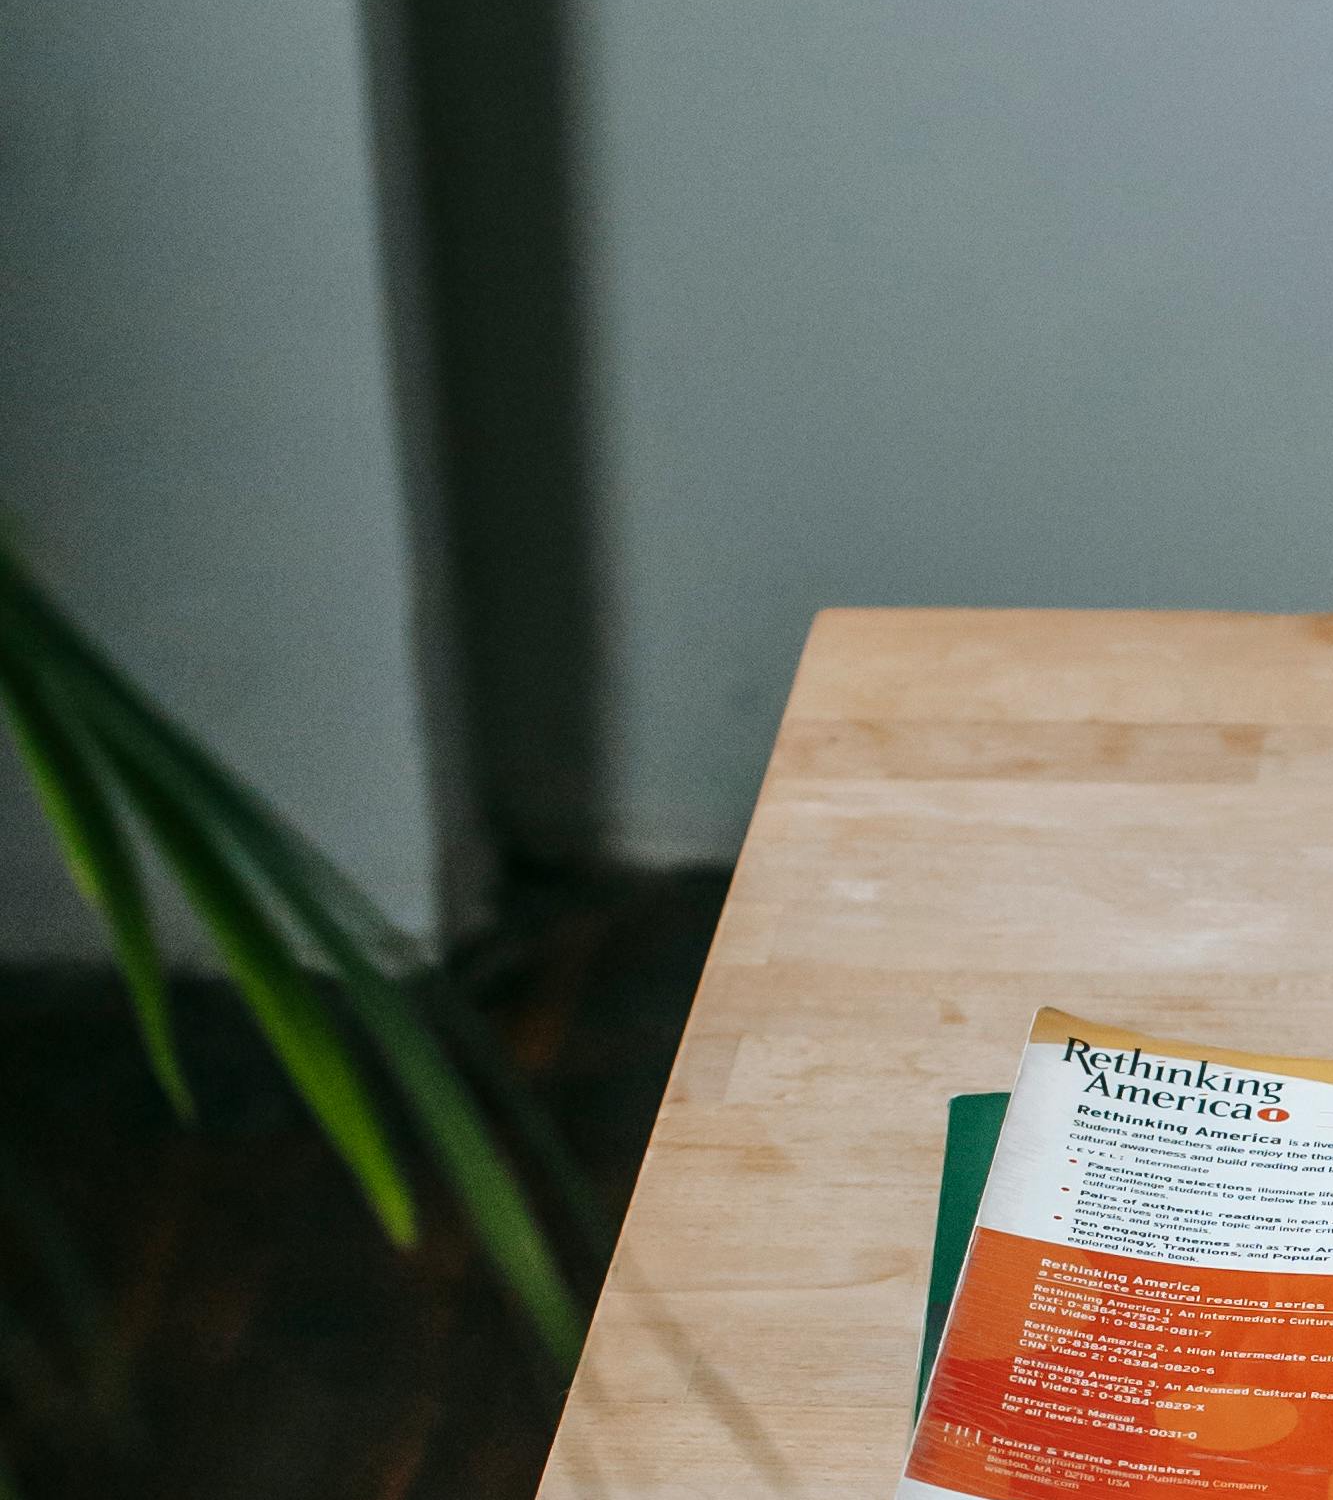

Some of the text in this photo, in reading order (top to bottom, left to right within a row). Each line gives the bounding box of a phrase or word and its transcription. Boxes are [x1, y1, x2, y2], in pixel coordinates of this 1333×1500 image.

[1062, 1036, 1284, 1104] Rethinking
[1084, 1071, 1251, 1121] America
[1073, 1119, 1128, 1136] Students
[1131, 1132, 1154, 1141] and
[1158, 1135, 1212, 1150] teachers
[1215, 1145, 1245, 1153] alike
[1248, 1149, 1283, 1158] enjoy
[1286, 1151, 1307, 1159] the
[1077, 1104, 1188, 1134] Rethinking
[1194, 1126, 1281, 1145] America
[1069, 1133, 1117, 1146] cultural
[1119, 1143, 1186, 1158] awareness
[1189, 1154, 1214, 1162] and
[1216, 1156, 1248, 1166] build
[1250, 1161, 1298, 1172] reading
[1040, 1258, 1200, 1292] Rethinking America
[1053, 1273, 1130, 1292] complete
[1134, 1287, 1201, 1302] cultural
[1206, 1296, 1269, 1308] reading
[1275, 1301, 1325, 1310] series
[1028, 1302, 1056, 1313] CNN
[1060, 1307, 1096, 1321] Video
[1032, 1292, 1062, 1305] Text:
[1034, 1283, 1102, 1306] Rethinking
[1106, 1299, 1160, 1314] America
[1178, 1309, 1195, 1318] An
[1199, 1312, 1285, 1324] Intermediate
[1019, 1338, 1046, 1350] CNN
[1050, 1344, 1087, 1358] Video
[1022, 1329, 1052, 1342] Text:
[1024, 1319, 1094, 1341] Rethinking
[1097, 1334, 1152, 1350] America
[1186, 1347, 1216, 1356] High
[1220, 1349, 1306, 1361] Intermediate
[1009, 1374, 1036, 1386] CNN
[1041, 1381, 1077, 1394] Video
[1012, 1365, 1042, 1378] Text:
[1014, 1356, 1084, 1378] Rethinking
[1088, 1371, 1143, 1386] America
[1164, 1382, 1181, 1391] An
[1185, 1384, 1249, 1395] Advanced
[1253, 1388, 1306, 1398] Cultural
[1001, 1402, 1020, 1412] for
[1024, 1408, 1041, 1416] all
[1045, 1410, 1088, 1425] levels:
[1087, 1409, 1135, 1423] Manual
